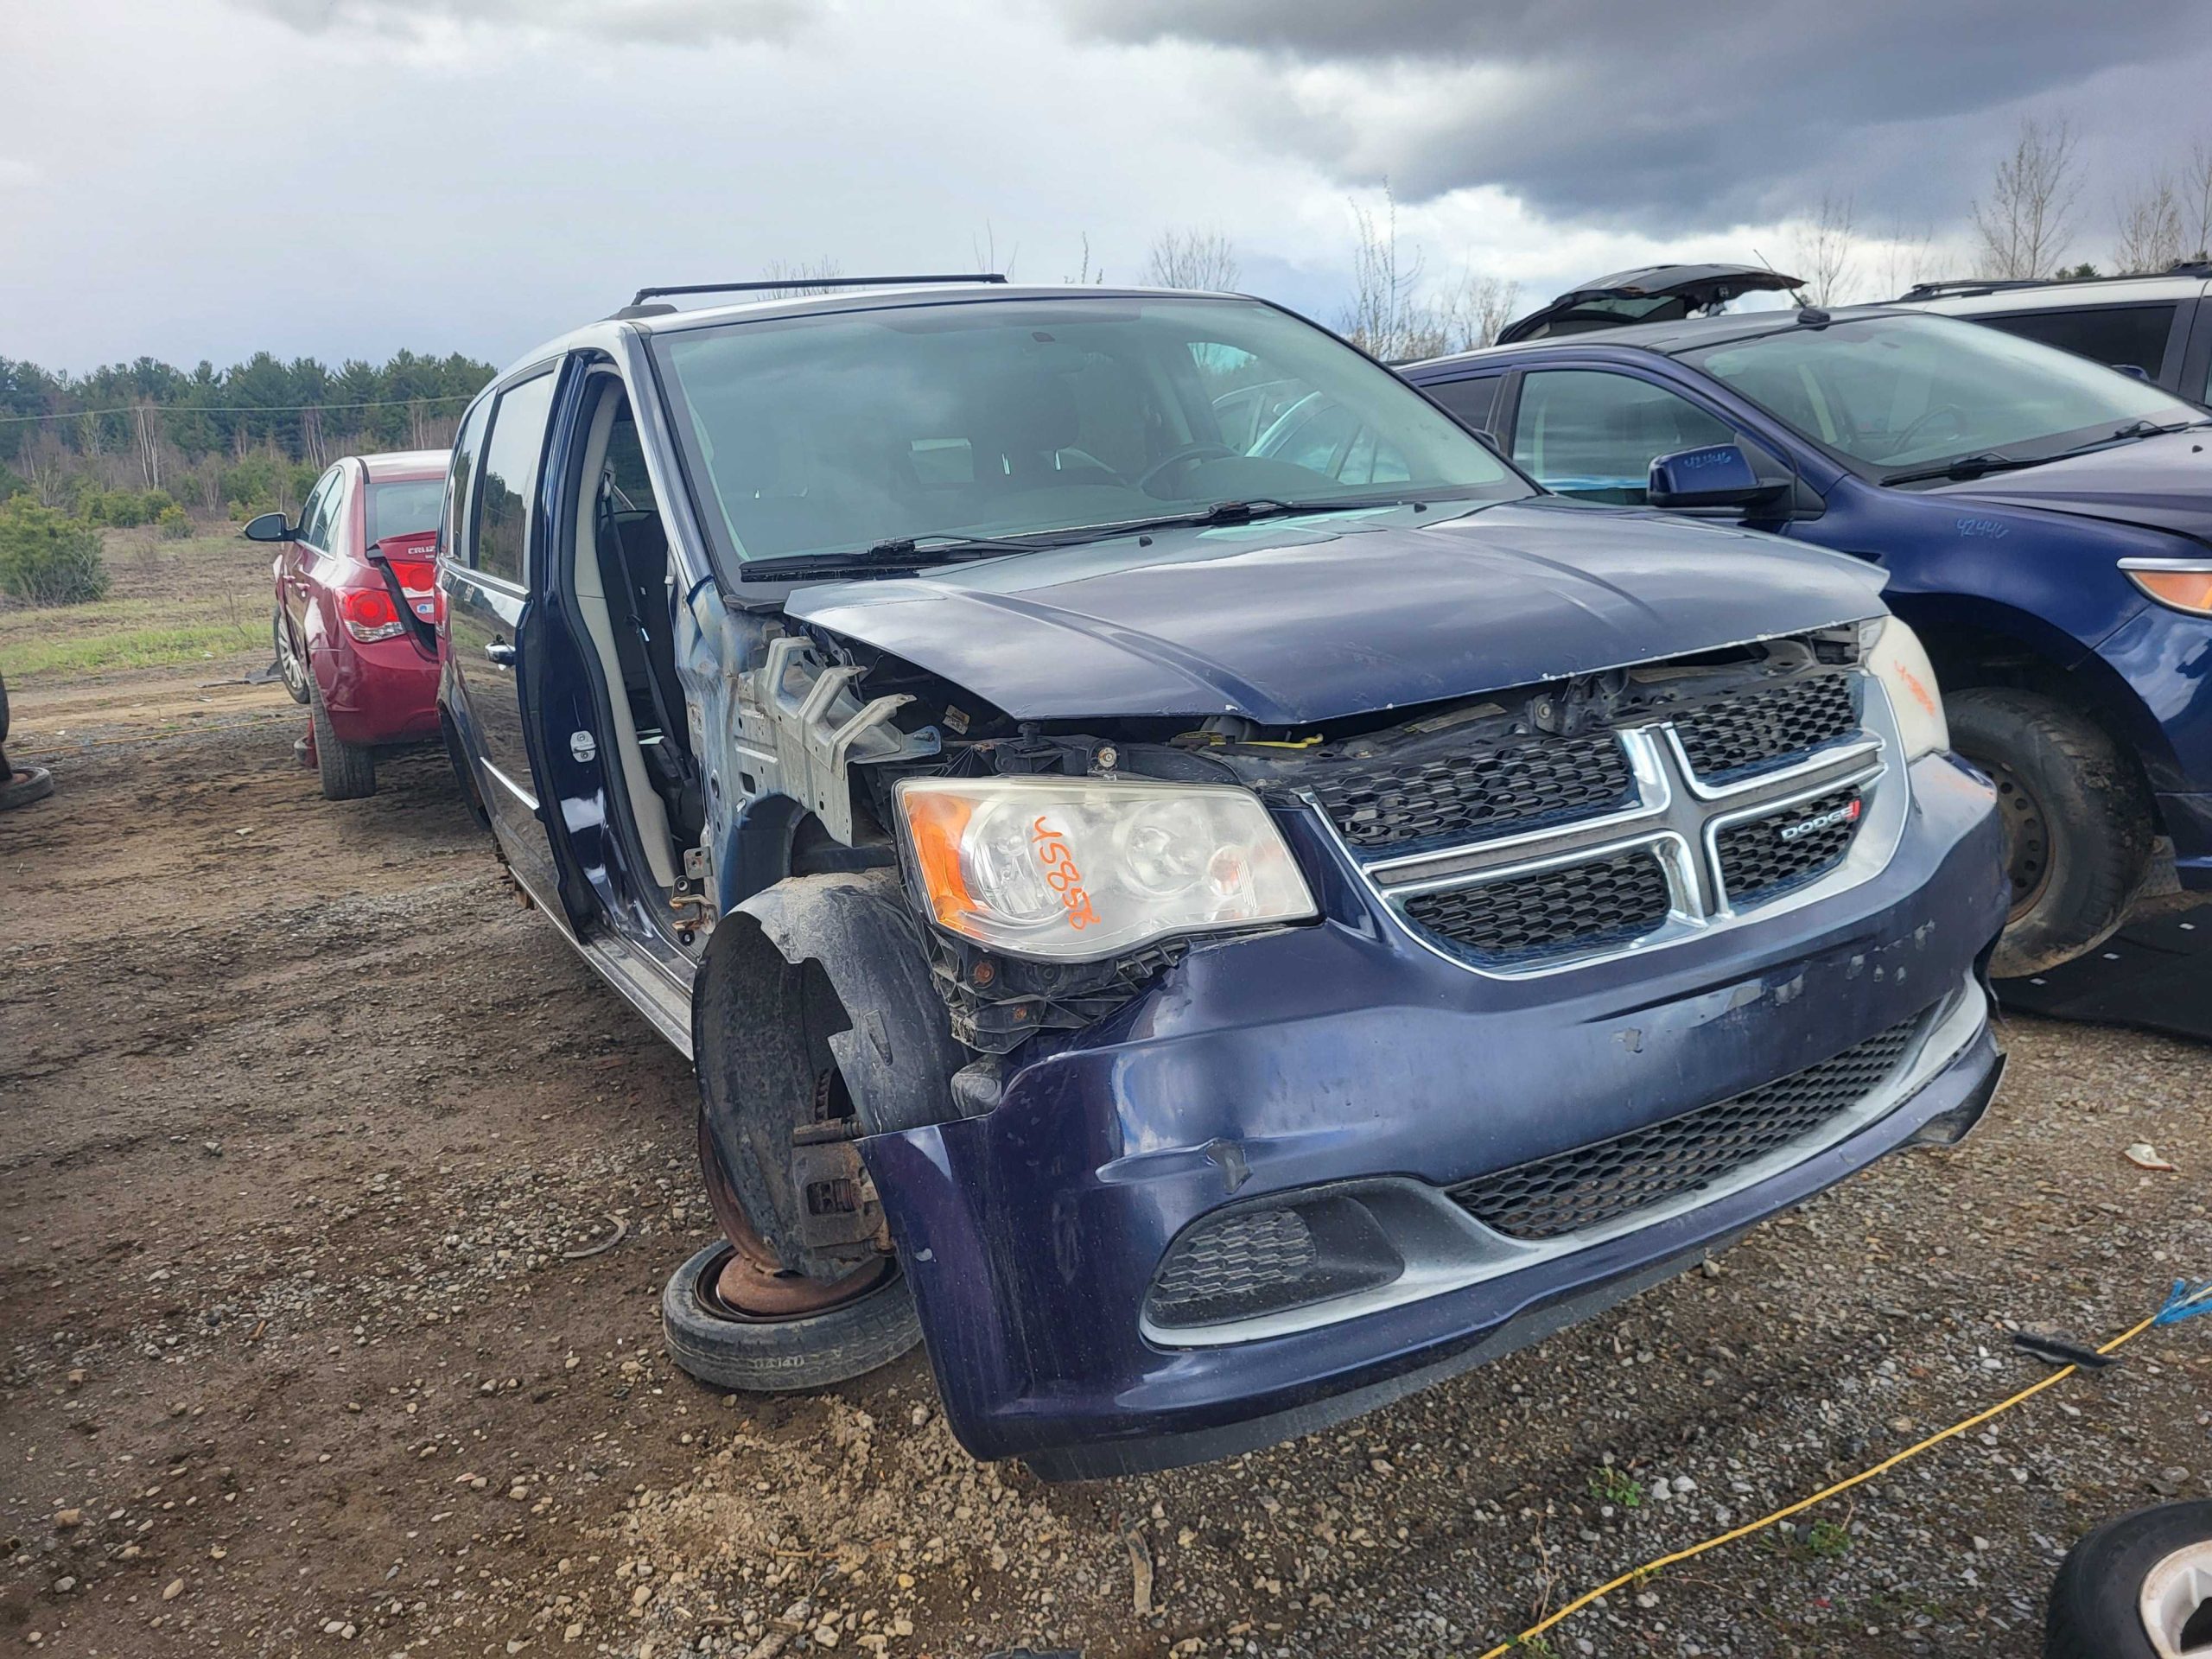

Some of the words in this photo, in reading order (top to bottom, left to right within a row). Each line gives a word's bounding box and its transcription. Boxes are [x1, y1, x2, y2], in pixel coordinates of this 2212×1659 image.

[1956, 518, 2010, 538] 42446
[1781, 804, 1853, 839] DODGE
[1032, 817, 1101, 930] 45858
